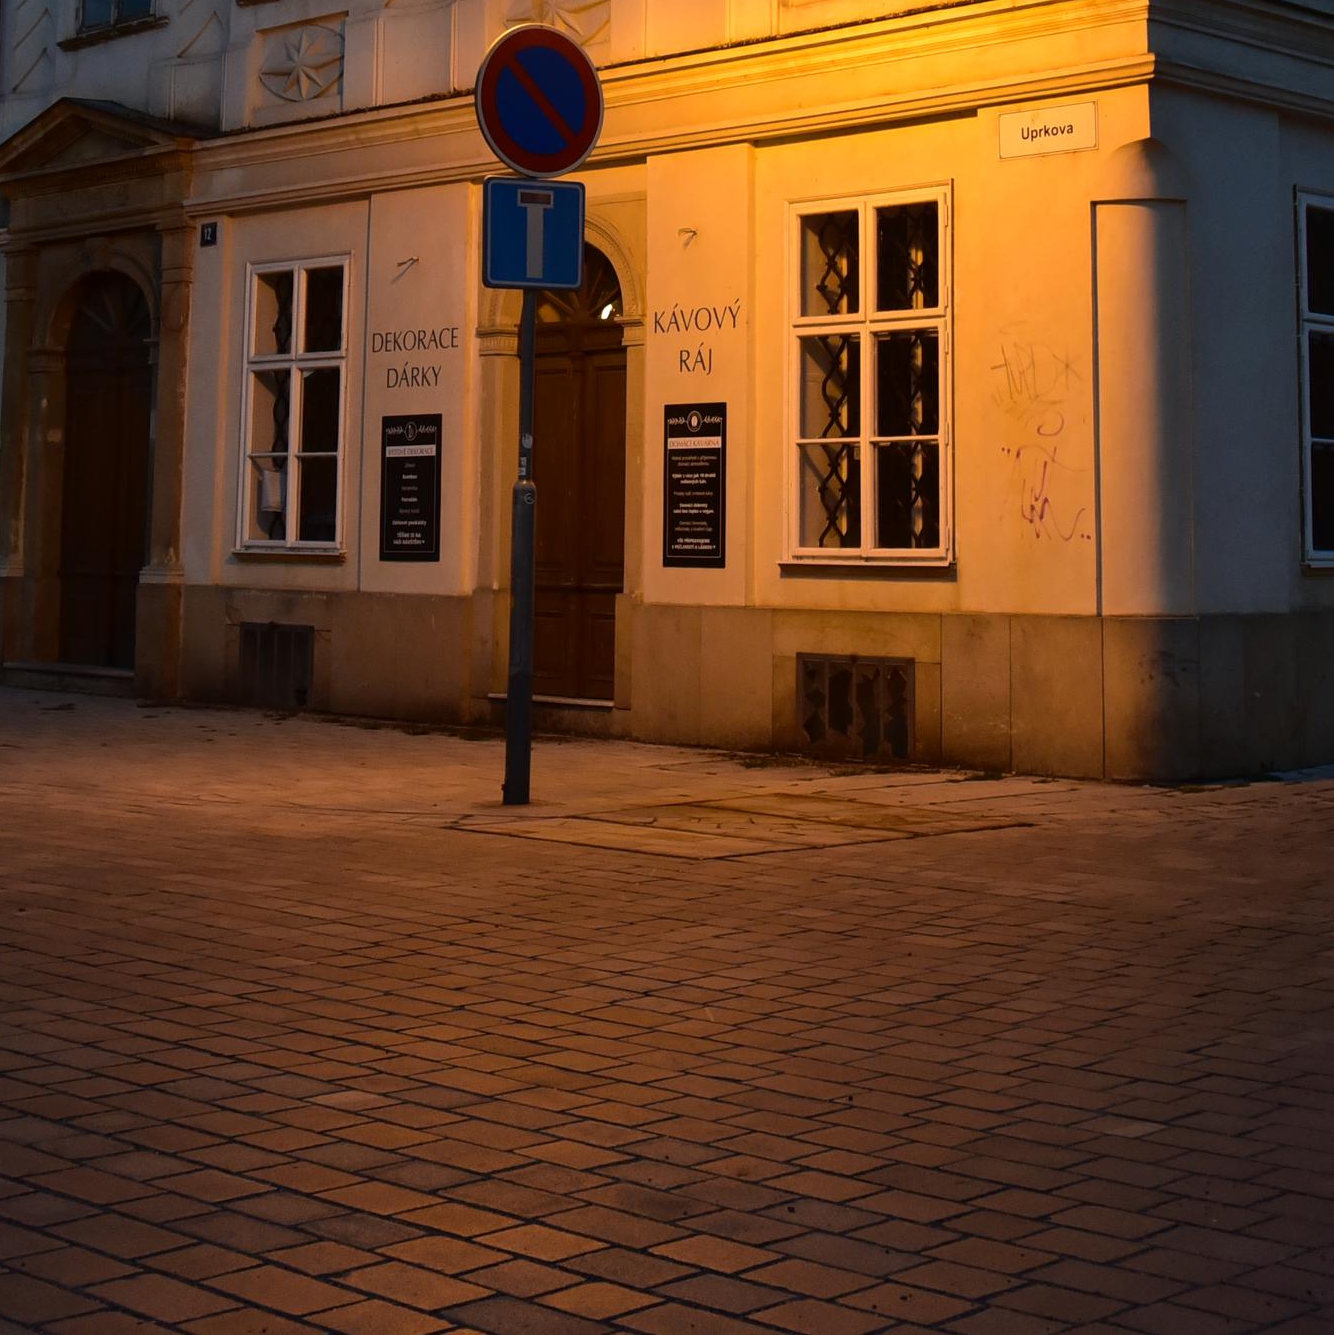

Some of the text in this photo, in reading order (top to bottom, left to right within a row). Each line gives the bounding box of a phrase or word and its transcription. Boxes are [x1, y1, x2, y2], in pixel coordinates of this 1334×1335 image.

[1021, 123, 1074, 142] Uprkova
[654, 297, 741, 334] KÁVOVÝ
[372, 327, 459, 353] DEKORACE
[679, 341, 712, 375] RÁJ
[386, 361, 442, 388] DÁRKY
